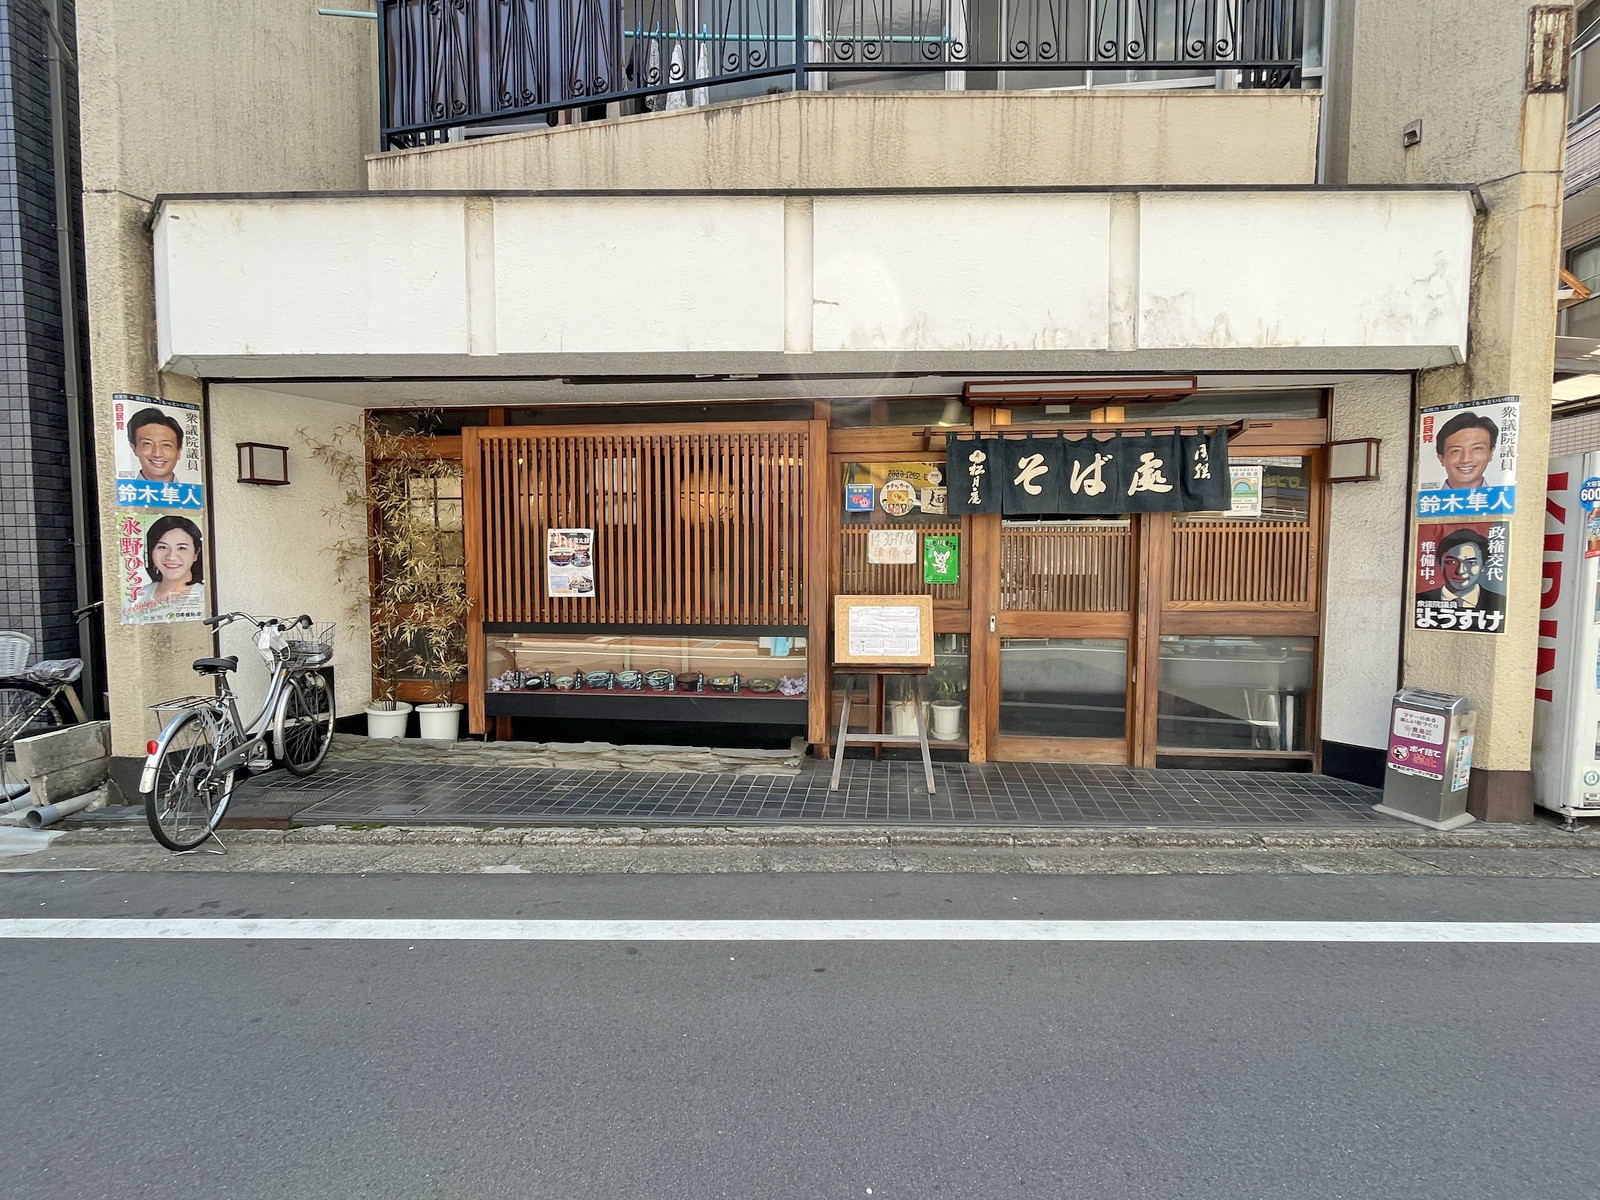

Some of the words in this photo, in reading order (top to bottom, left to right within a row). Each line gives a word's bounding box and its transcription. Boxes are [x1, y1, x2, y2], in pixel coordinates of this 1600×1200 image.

[115, 403, 124, 431] 自民党
[1422, 416, 1434, 443] 自民党
[185, 412, 199, 471] 衆議院議員
[1500, 405, 1517, 471] 衆議院議員
[118, 483, 201, 505] 鈴木隼人
[1419, 491, 1513, 513] 鈴木隼人
[121, 516, 145, 602] 永野ひろ子
[1487, 526, 1506, 581] 政権交代
[1416, 607, 1504, 631] ようすけ
[1409, 745, 1442, 758] ポイ捨て
